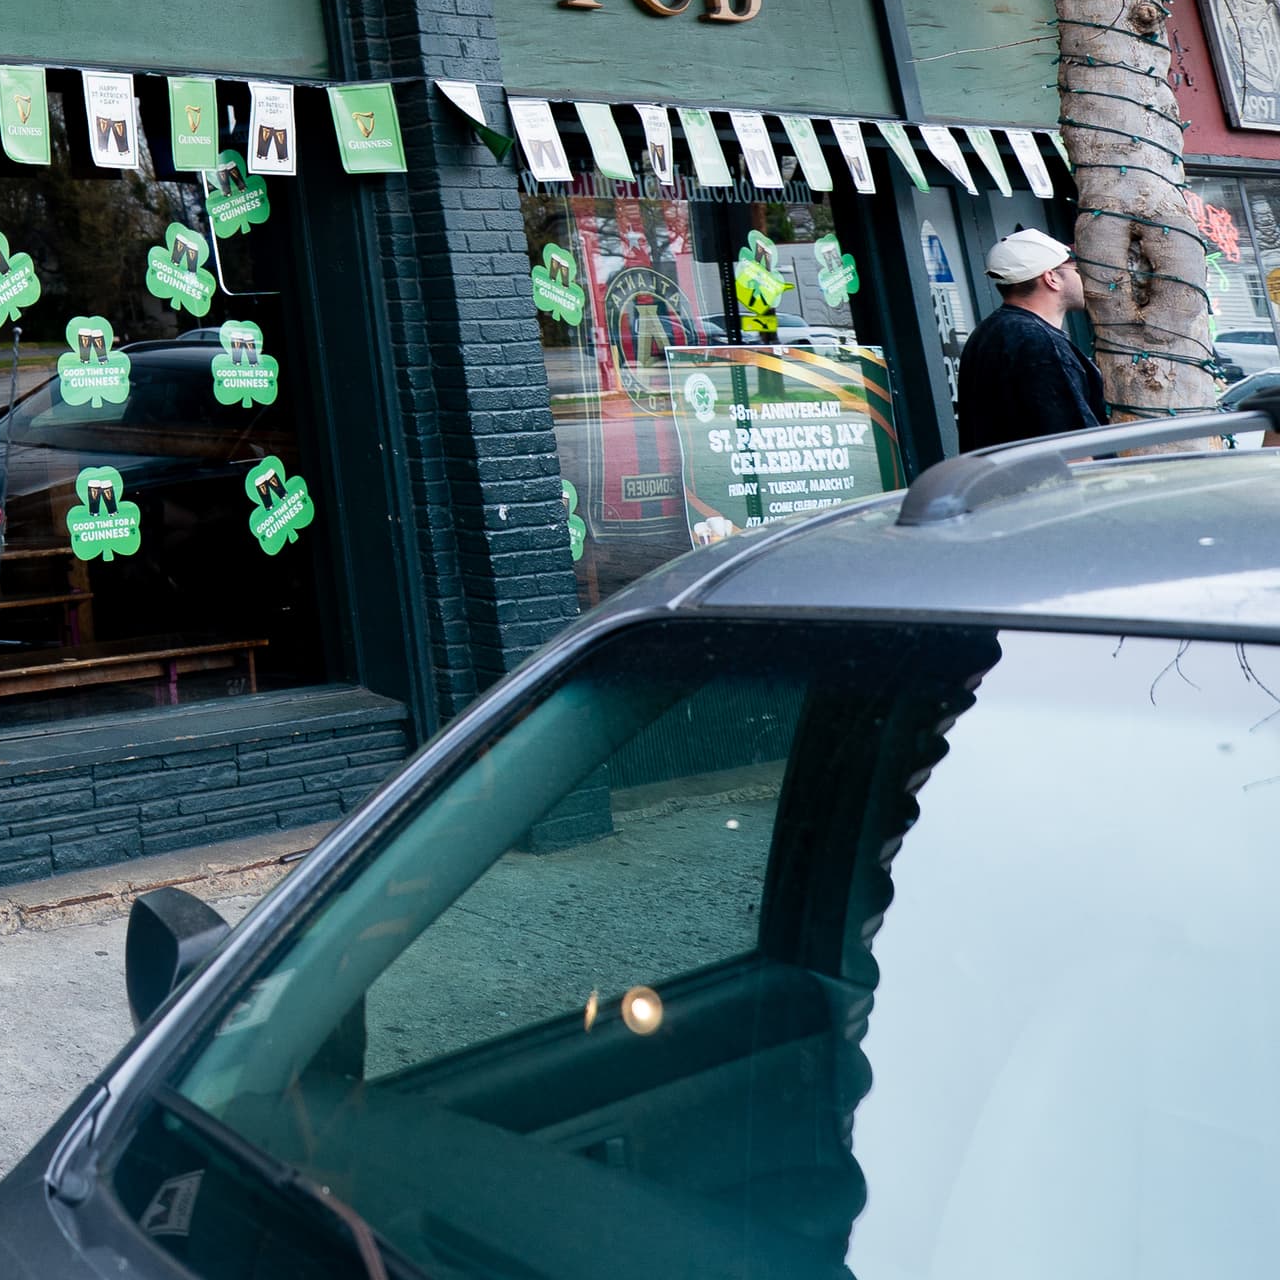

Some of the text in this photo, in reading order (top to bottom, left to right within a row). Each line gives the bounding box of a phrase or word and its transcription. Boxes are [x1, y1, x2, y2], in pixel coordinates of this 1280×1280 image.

[8, 124, 42, 137] GUINNESS
[178, 135, 212, 145] GUINNESS
[348, 138, 393, 149] GUINNESS
[10, 270, 25, 283] FOR
[71, 377, 120, 387] GUINNESS
[224, 379, 269, 387] GUINNESS
[729, 404, 758, 421] 38TH
[735, 425, 833, 451] PATRICK'S
[810, 478, 841, 492] MARCH
[73, 522, 94, 531] GOOD
[96, 520, 113, 528] TIME
[114, 518, 129, 526] FOR
[81, 528, 130, 541] GUINNESS
